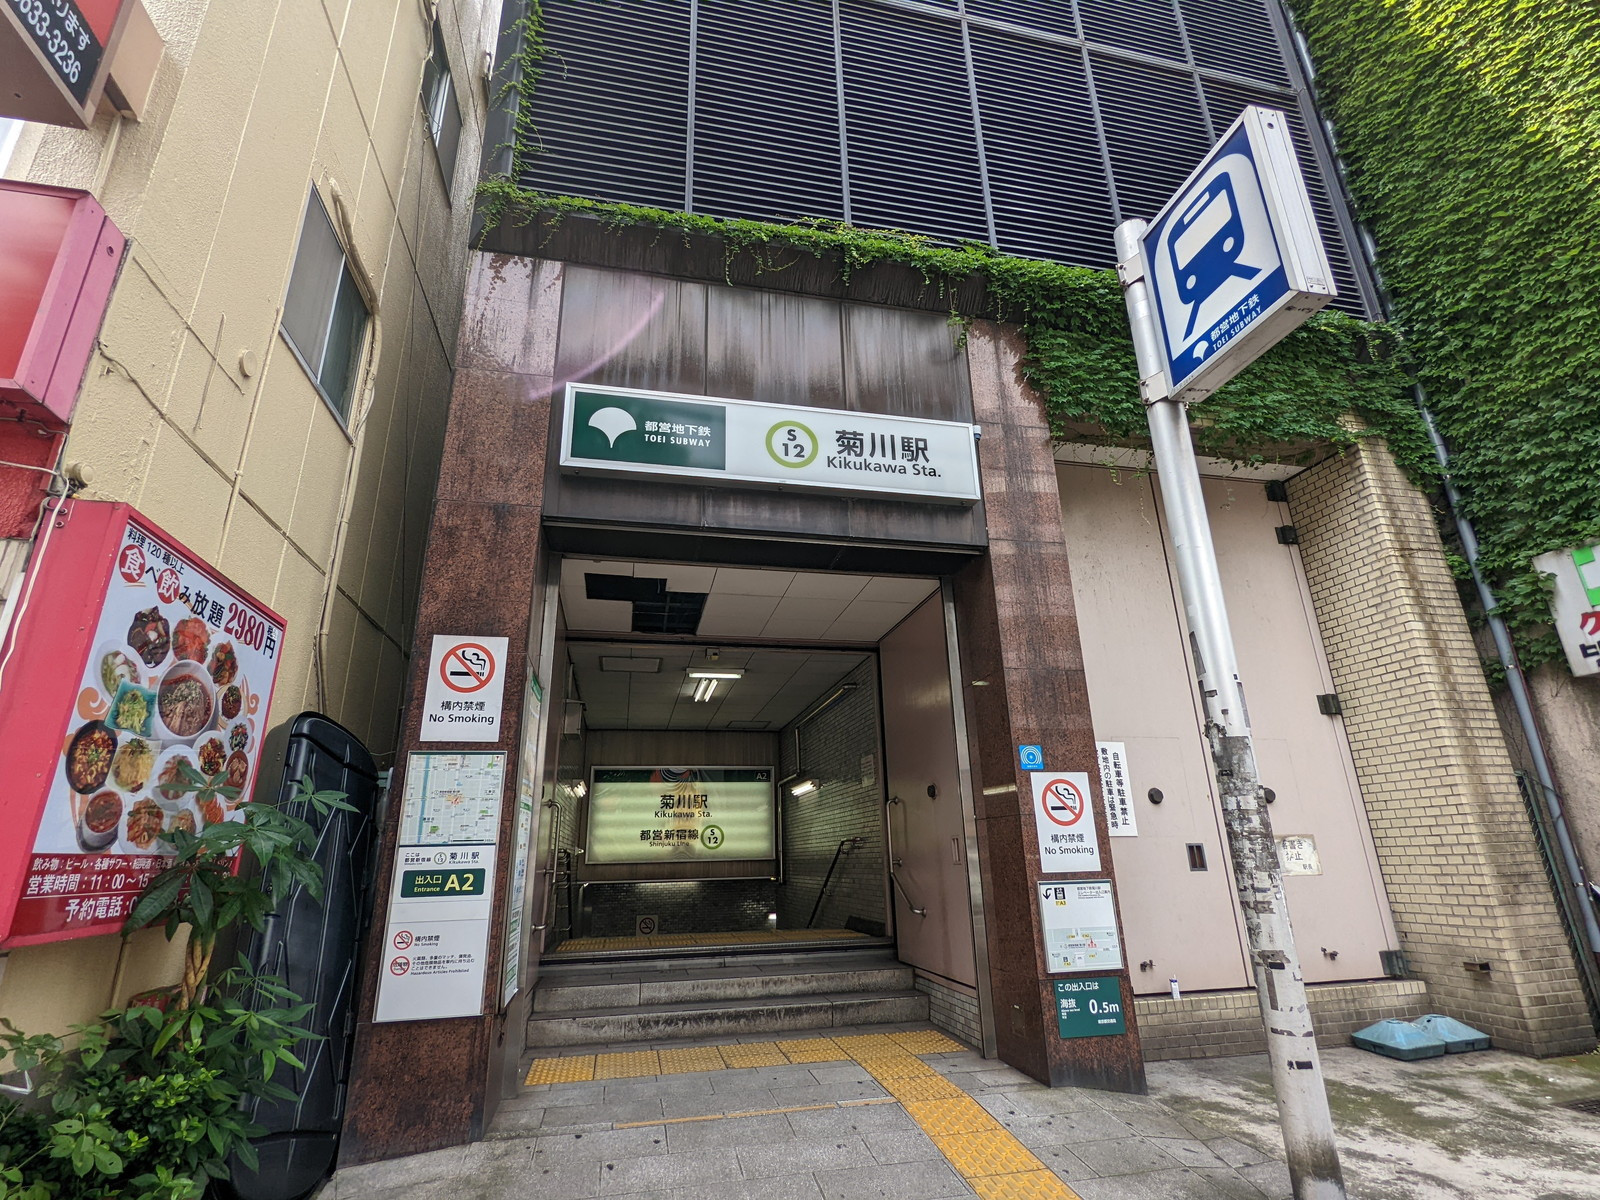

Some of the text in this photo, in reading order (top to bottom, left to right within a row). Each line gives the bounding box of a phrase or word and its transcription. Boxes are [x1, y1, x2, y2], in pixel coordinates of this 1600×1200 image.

[1210, 293, 1260, 341] 都営地下鉄
[1212, 305, 1261, 351] TOEI SUBWAY
[644, 420, 711, 437] 都営地下鉄
[787, 429, 796, 441] S
[644, 433, 711, 447] TOEI SUBWAY
[836, 429, 930, 463] 菊川駅
[782, 442, 805, 458] 12
[826, 455, 942, 478] Kikukawa Sta.
[223, 602, 266, 651] 2980
[262, 635, 277, 660] 円
[441, 700, 486, 712] 構内禁煙
[429, 713, 495, 726] No Smoking
[756, 772, 768, 780] A2
[1100, 747, 1119, 830] 敷地内の駐車は緊急時
[1112, 751, 1131, 826] 自転車等駐車禁止
[660, 794, 708, 810] 菊川駅
[654, 810, 713, 819] Kikukawa Sta.
[639, 829, 699, 841] 都営新宿線
[707, 836, 719, 845] 12
[1050, 833, 1085, 844] 構内禁煙
[449, 851, 480, 861] 菊川駅
[1044, 845, 1095, 856] No Smoking
[414, 875, 443, 885] 出入口
[443, 873, 475, 891] A2
[1057, 981, 1100, 992] この出入口は
[1060, 998, 1077, 1009] 海抜
[1088, 998, 1120, 1014] 0.5m
